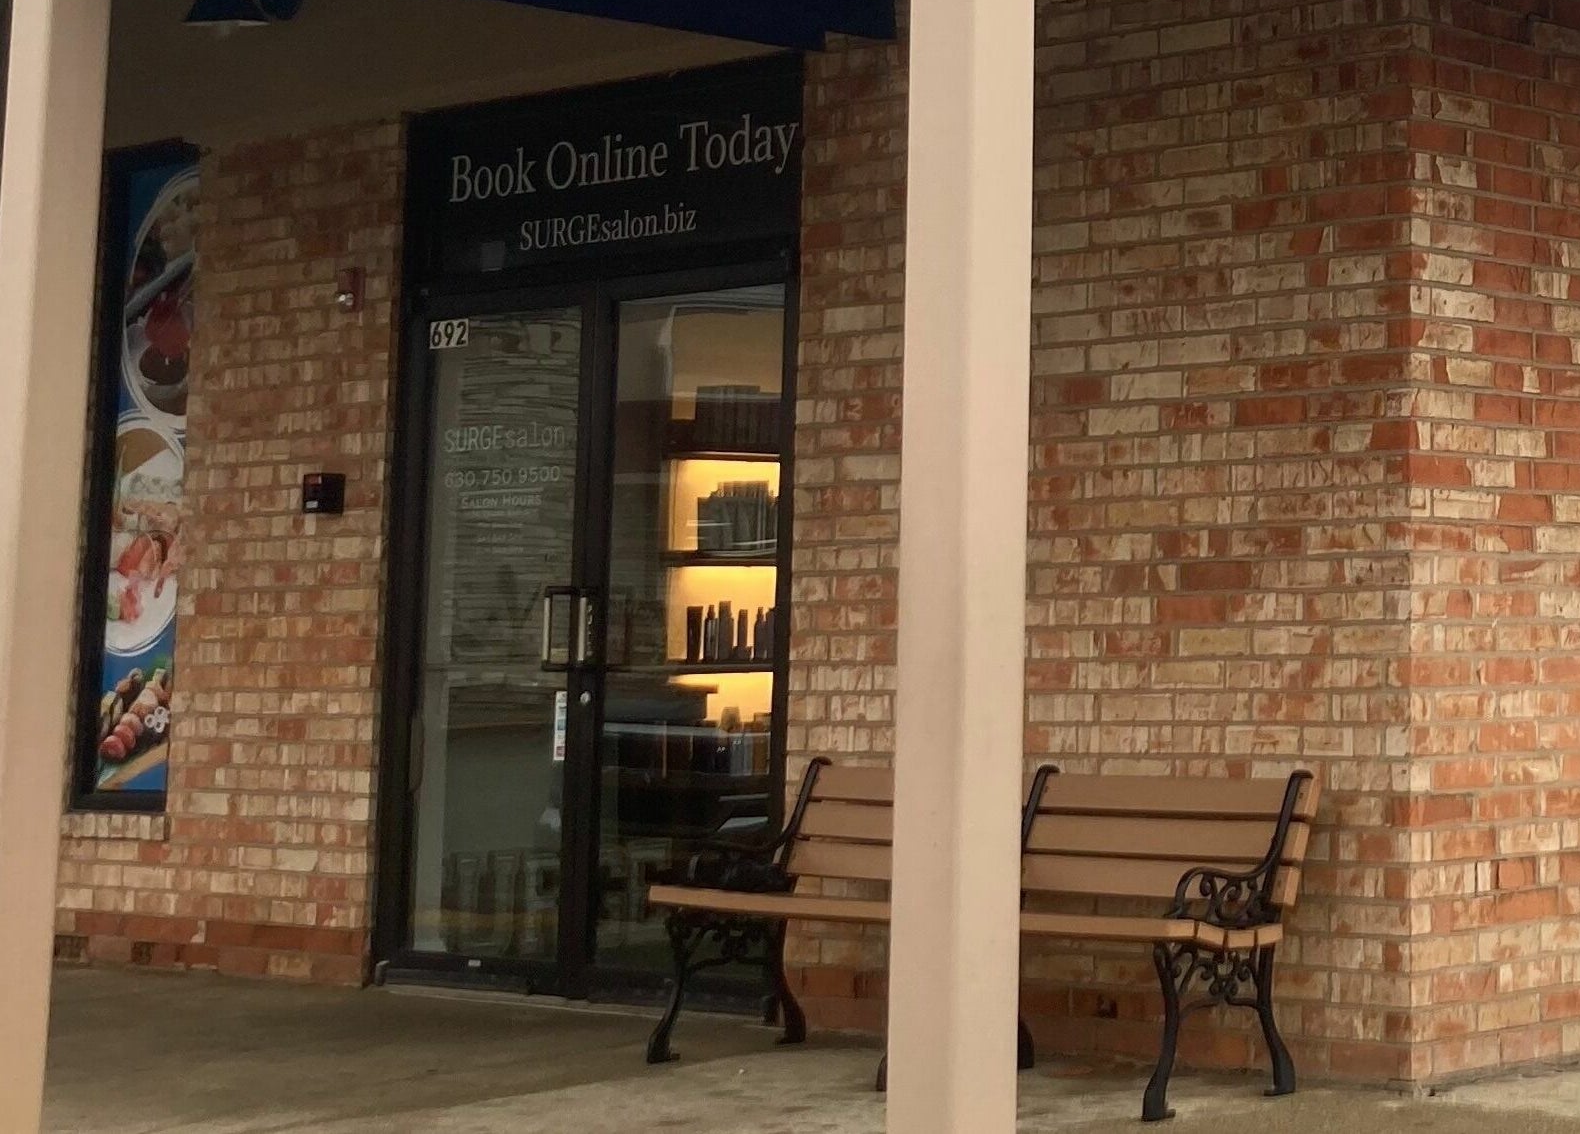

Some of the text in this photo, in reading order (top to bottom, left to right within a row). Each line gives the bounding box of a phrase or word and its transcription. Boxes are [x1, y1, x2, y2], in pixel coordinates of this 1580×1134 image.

[449, 114, 799, 203] Book Online Today
[520, 202, 697, 251] SURGEsalon.biz
[430, 320, 468, 348] 692
[444, 422, 565, 453] SURGEsalon
